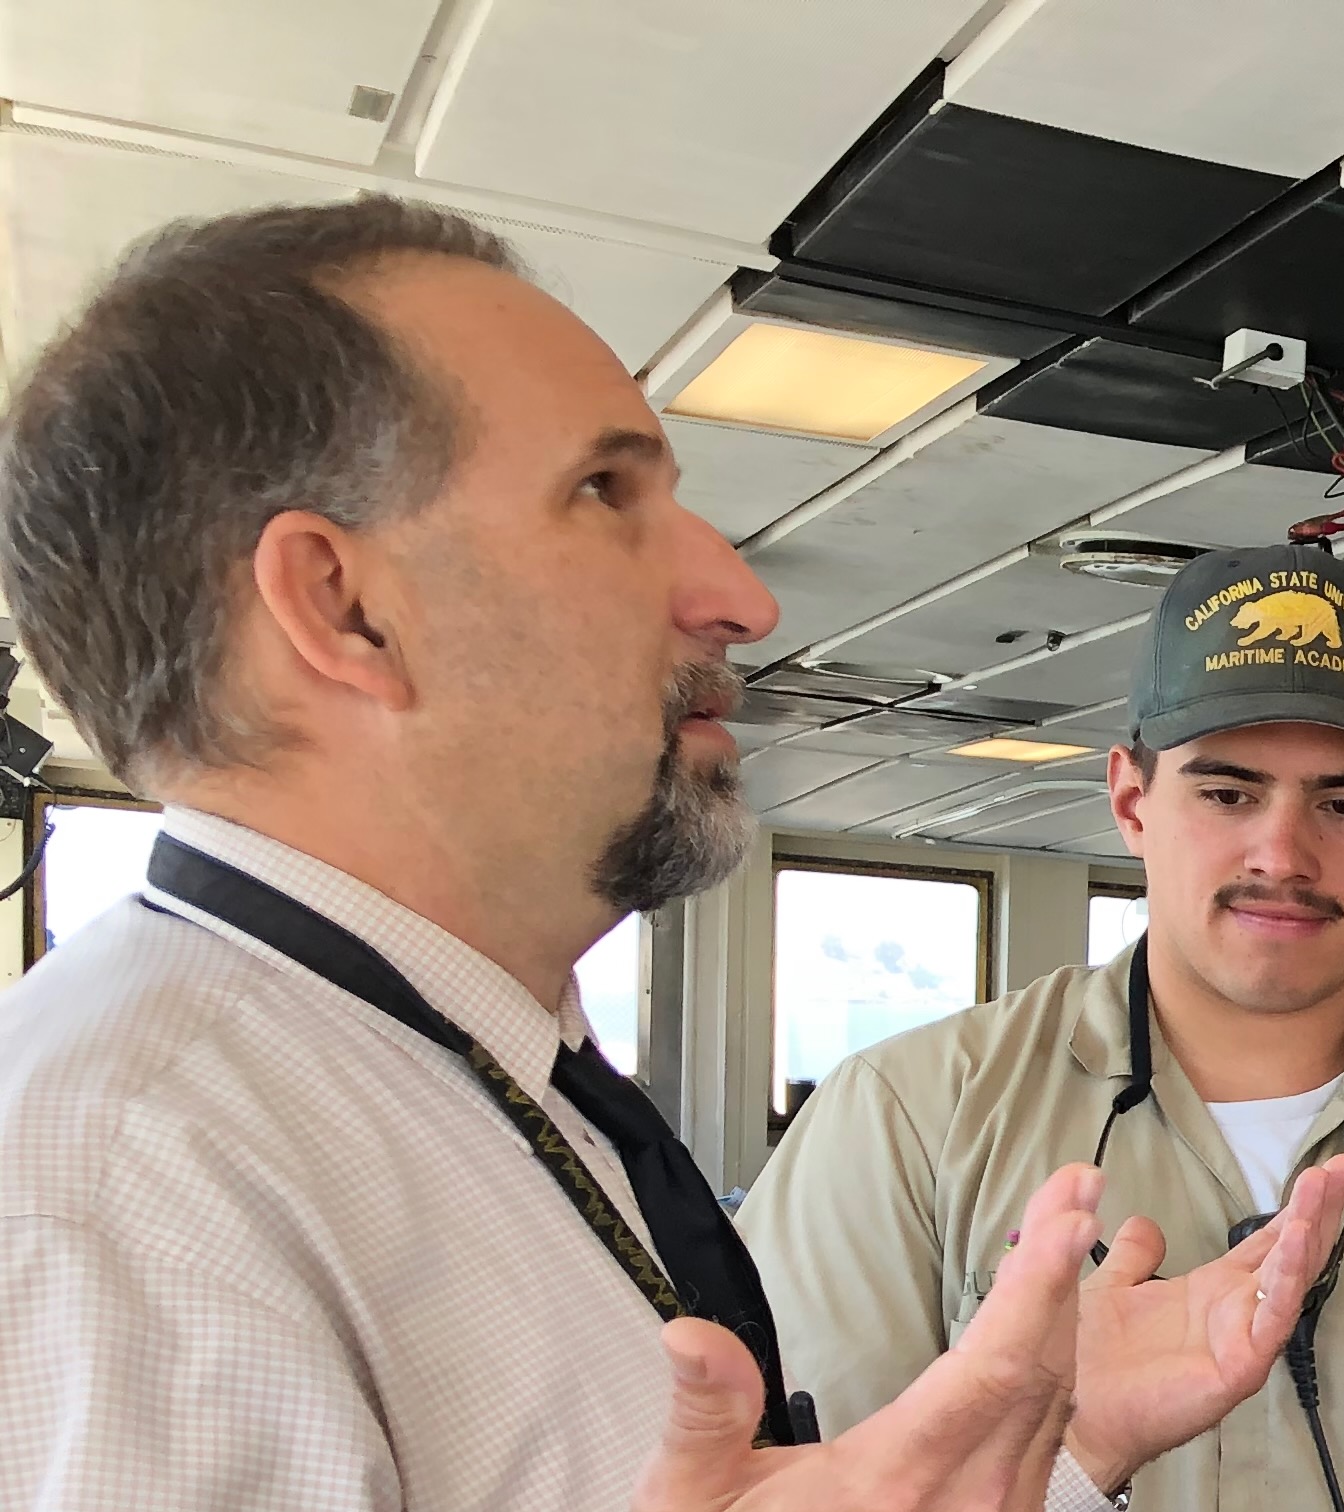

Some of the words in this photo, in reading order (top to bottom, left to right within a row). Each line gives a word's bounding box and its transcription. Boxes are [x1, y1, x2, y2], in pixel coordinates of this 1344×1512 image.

[1185, 577, 1264, 632] CALIFORNIA
[1269, 571, 1318, 590] STATE
[1205, 648, 1284, 672] MARITIME
